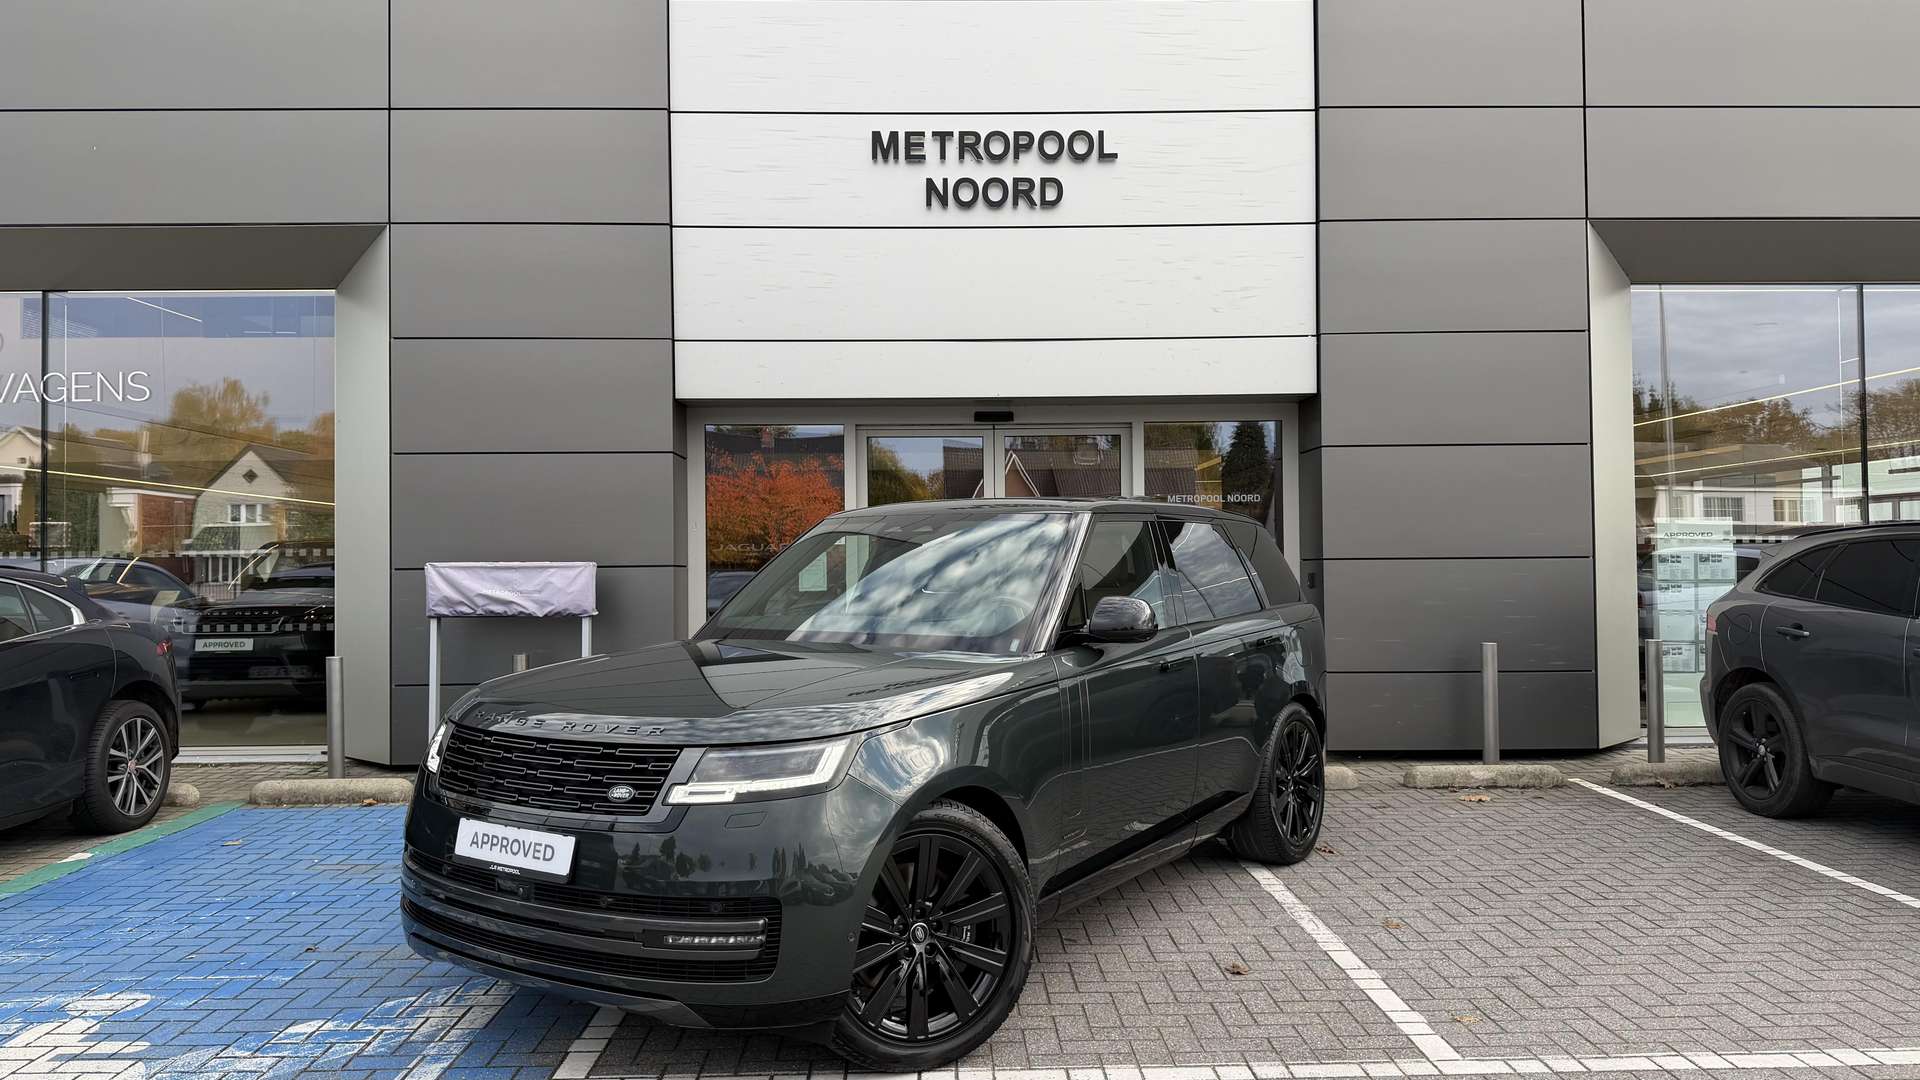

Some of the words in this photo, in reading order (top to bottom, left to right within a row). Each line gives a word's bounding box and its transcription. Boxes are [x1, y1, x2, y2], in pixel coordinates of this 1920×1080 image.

[871, 130, 1118, 161] METROPOOL
[925, 177, 1064, 208] NOORD
[1167, 494, 1225, 503] METROPOOL
[1227, 494, 1261, 502] NOORD
[202, 640, 246, 649] APPROVED
[475, 710, 546, 728] RANGE
[561, 720, 666, 737] ROVER
[470, 831, 555, 862] APPROVED
